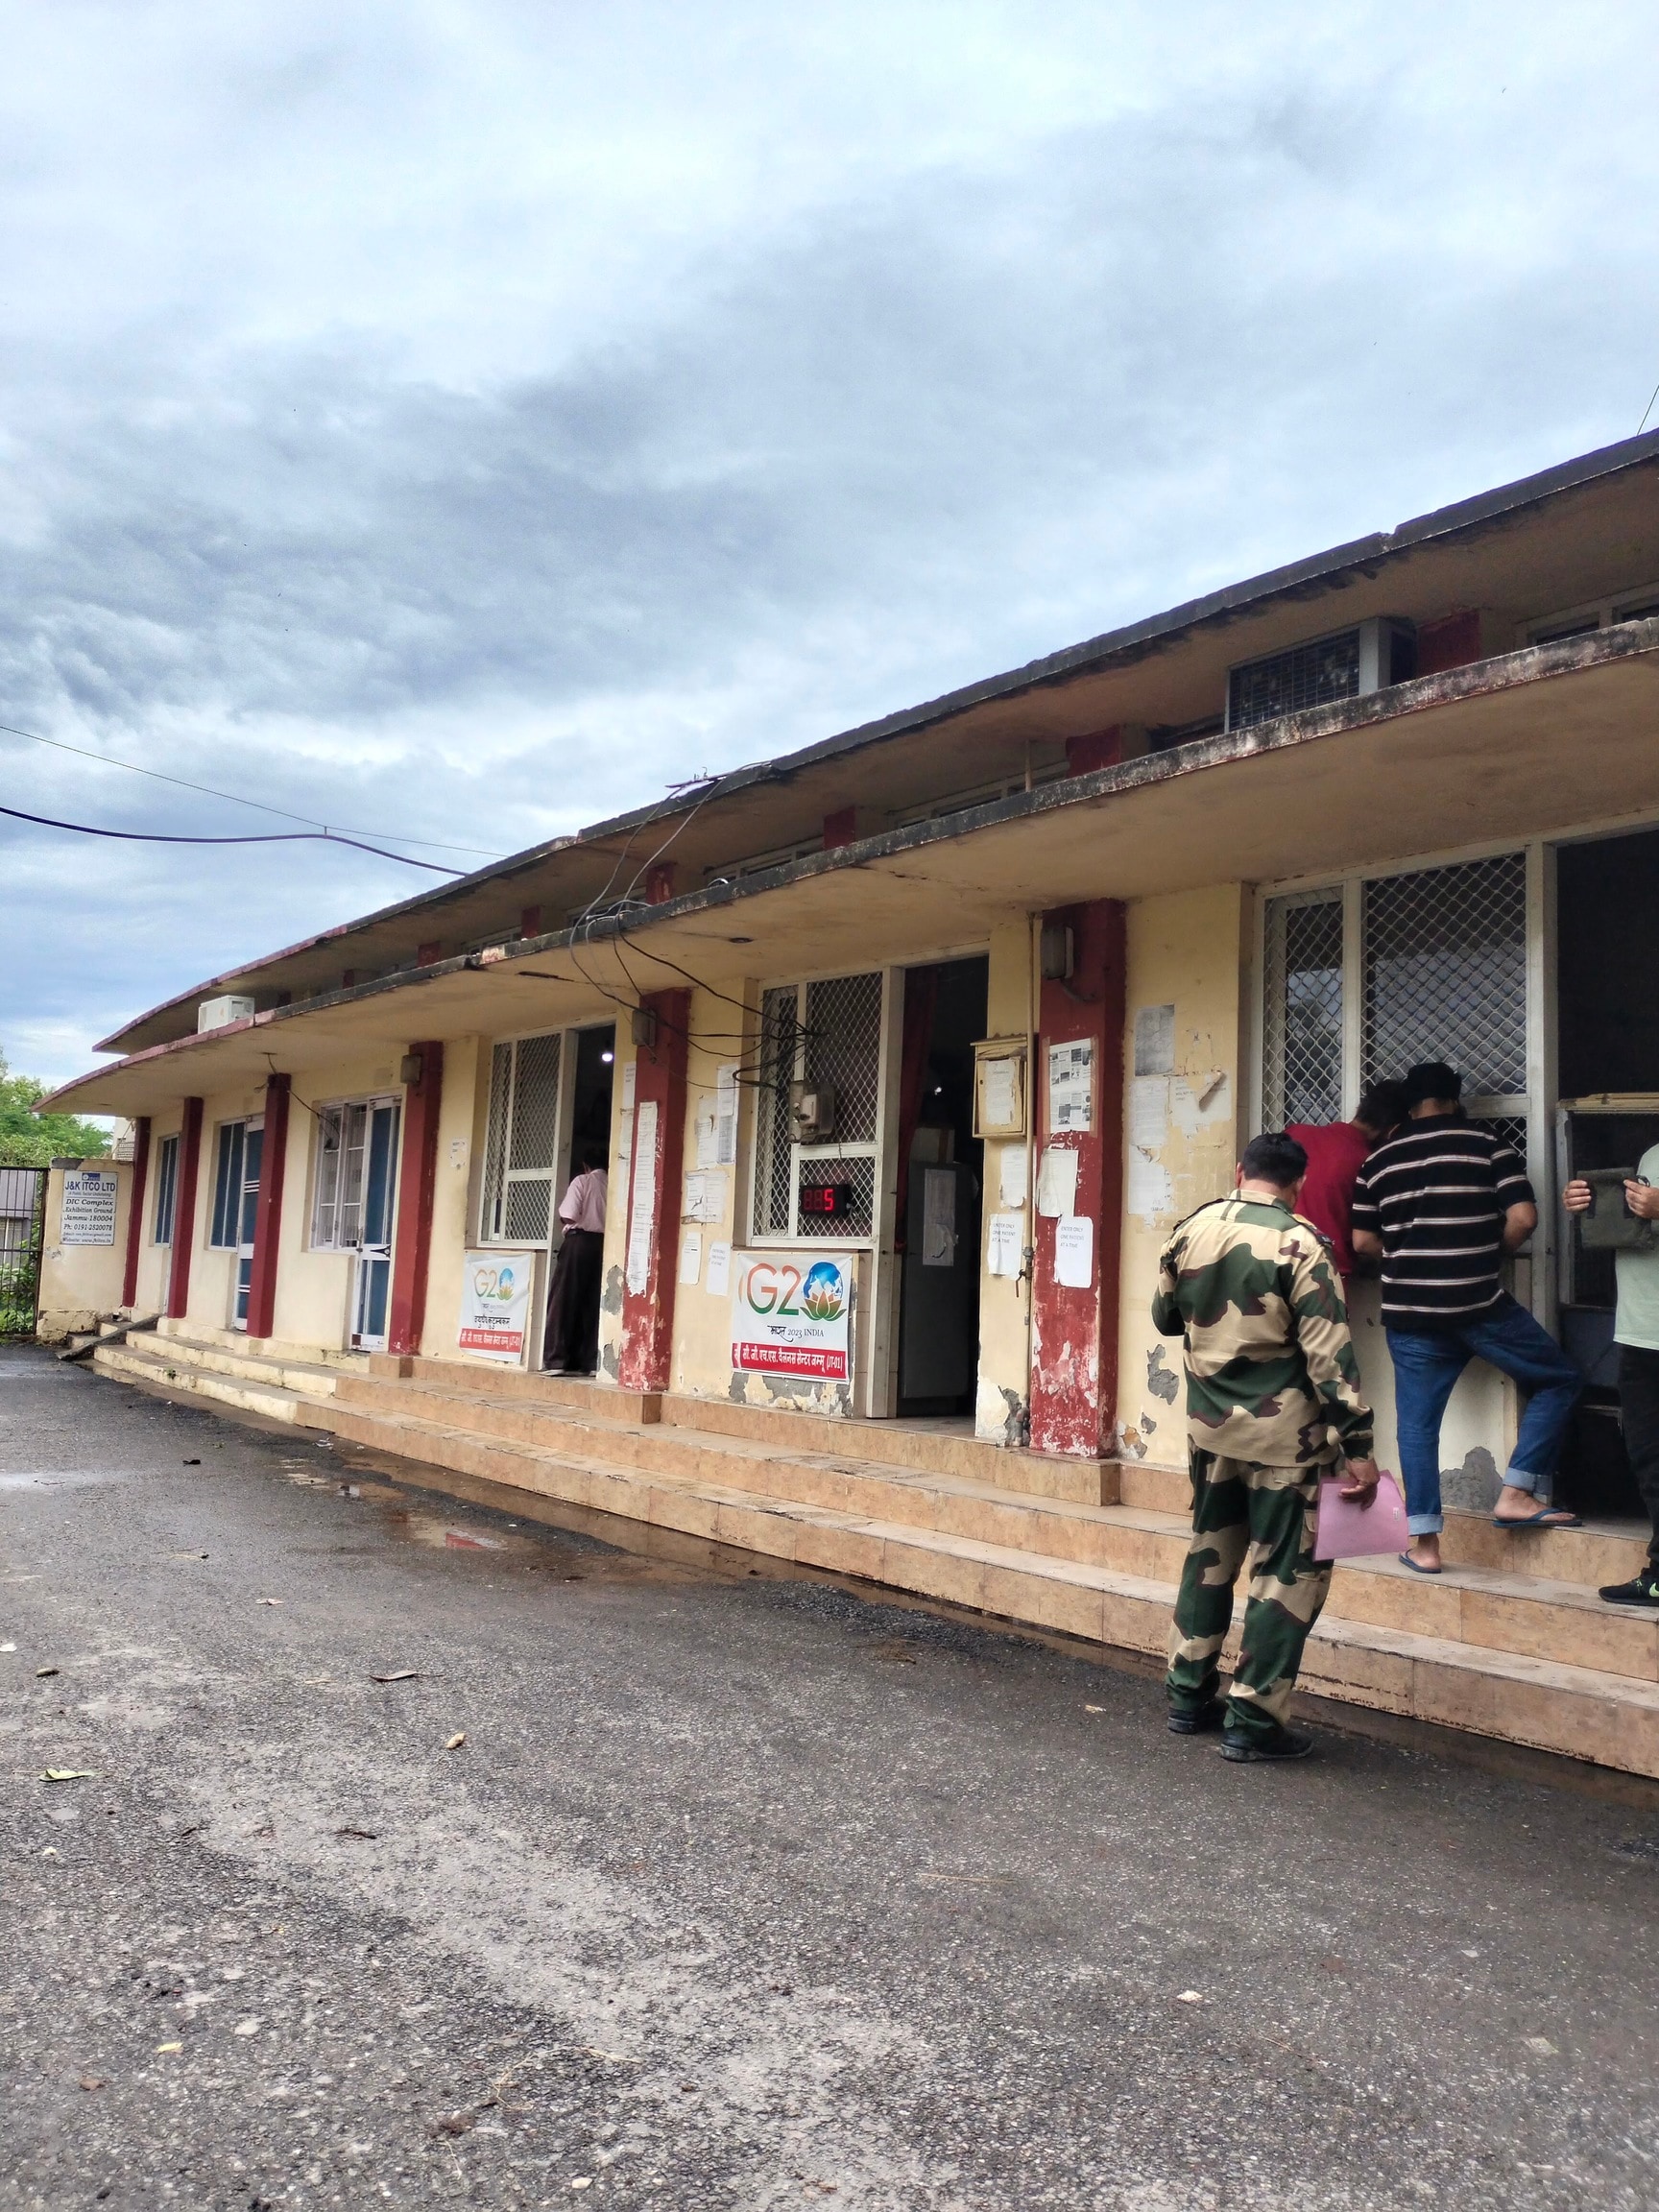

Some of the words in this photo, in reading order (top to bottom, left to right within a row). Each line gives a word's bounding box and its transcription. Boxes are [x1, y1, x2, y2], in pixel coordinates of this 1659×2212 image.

[65, 1181, 81, 1190] J&K
[82, 1182, 100, 1190] ITCO
[102, 1182, 115, 1191] LTD
[824, 1189, 833, 1211] 5
[787, 1329, 803, 1338] 2023
